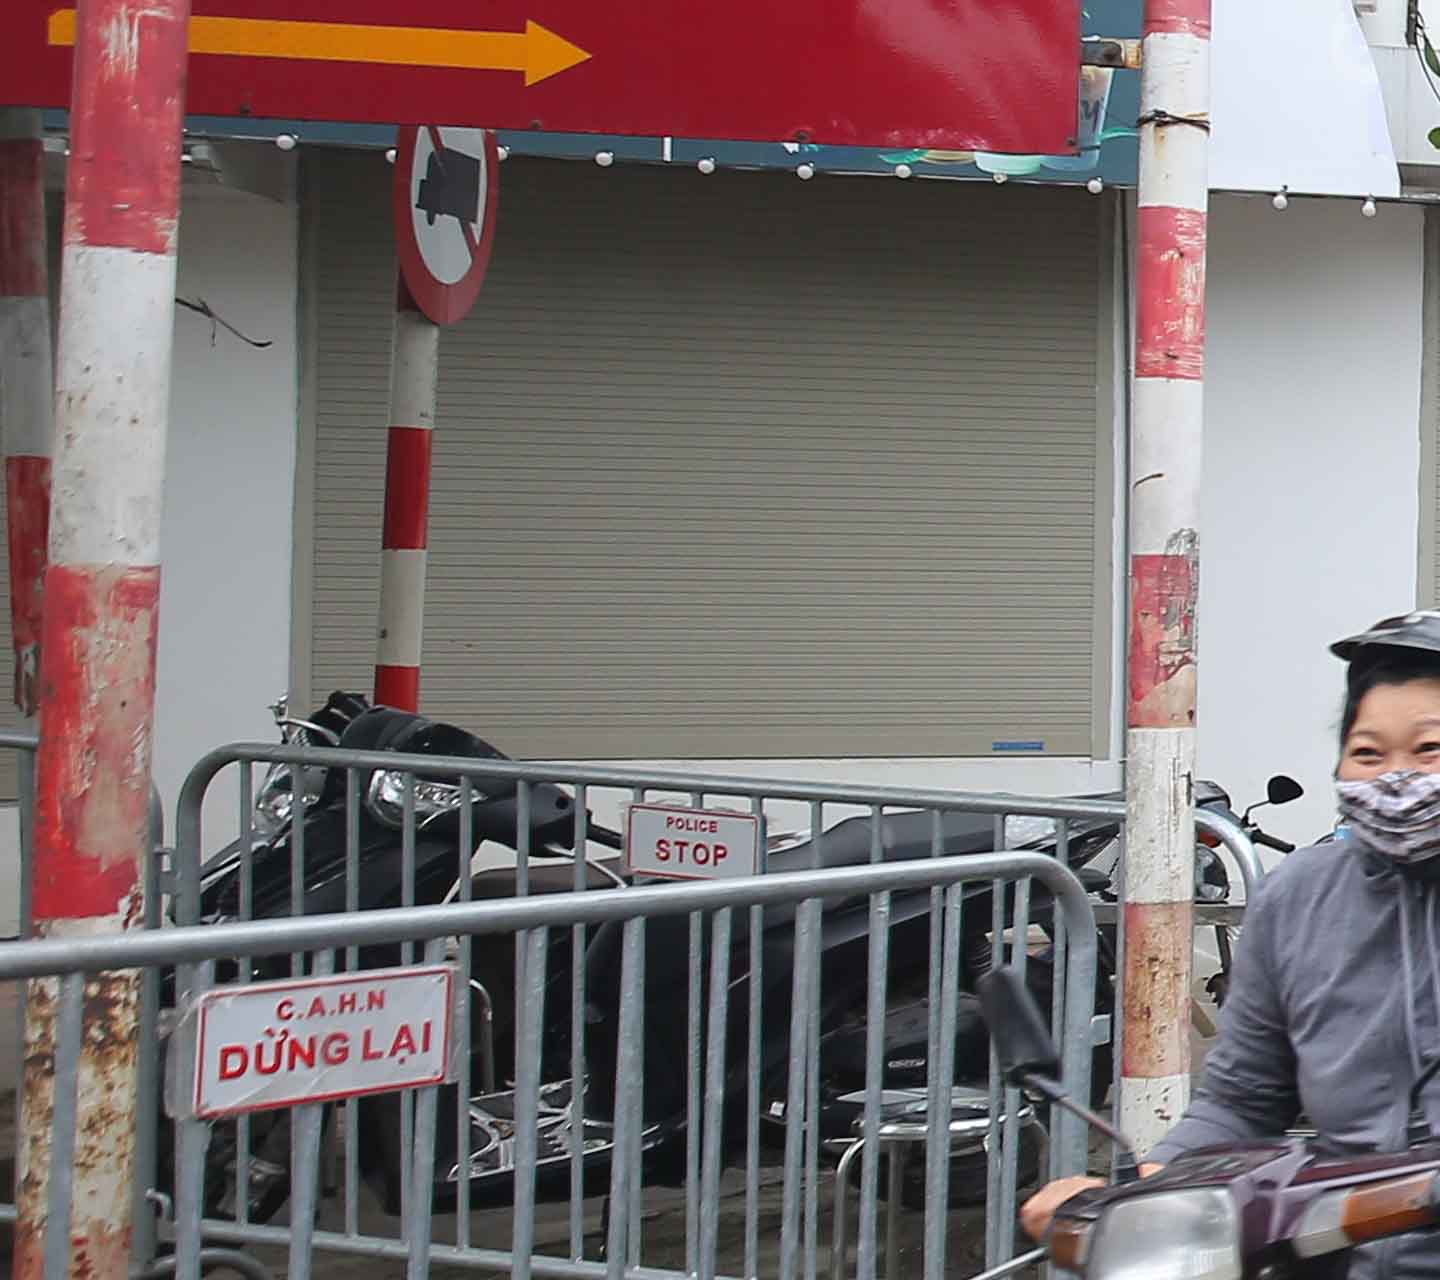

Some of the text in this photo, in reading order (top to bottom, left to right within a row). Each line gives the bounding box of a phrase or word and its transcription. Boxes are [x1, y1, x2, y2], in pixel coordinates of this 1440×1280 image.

[665, 815, 720, 836] POLICE
[654, 836, 731, 868] STOP
[276, 988, 388, 1023] C.A.H.N
[218, 1019, 433, 1087] DỪNG LẠI
